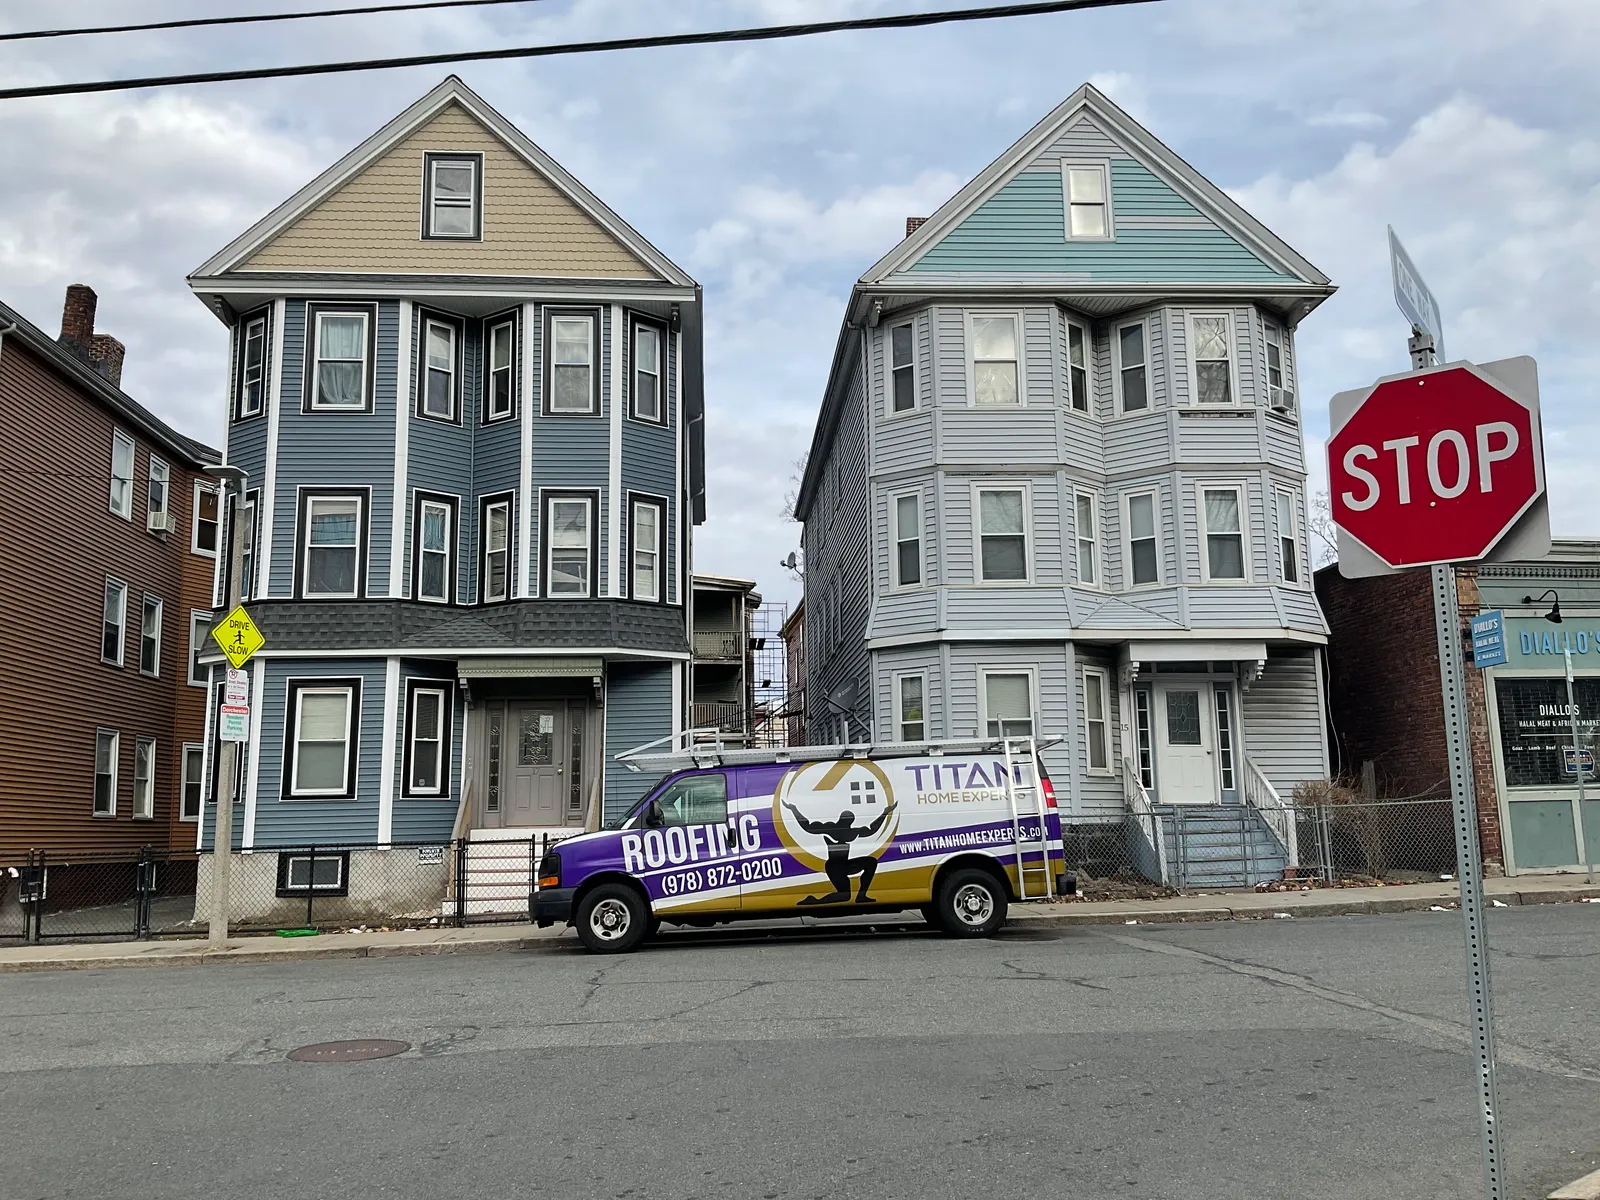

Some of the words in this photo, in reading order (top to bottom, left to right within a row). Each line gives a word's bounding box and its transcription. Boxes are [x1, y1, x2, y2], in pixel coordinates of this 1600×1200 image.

[1341, 421, 1519, 512] STOP
[229, 619, 250, 631] DRIVE
[1473, 618, 1498, 634] DIALLO'S
[228, 644, 249, 655] SLOW
[1539, 704, 1580, 716] DIALLOS
[1120, 723, 1129, 731] 15
[1519, 720, 1536, 728] HALAL
[1537, 720, 1551, 728] MEAT
[904, 761, 1022, 791] TITAN
[917, 792, 960, 804] HOME
[962, 789, 1026, 802] EXPERS
[621, 814, 761, 873] ROOFING
[661, 871, 703, 896] (978)
[707, 857, 783, 887] 872-0200
